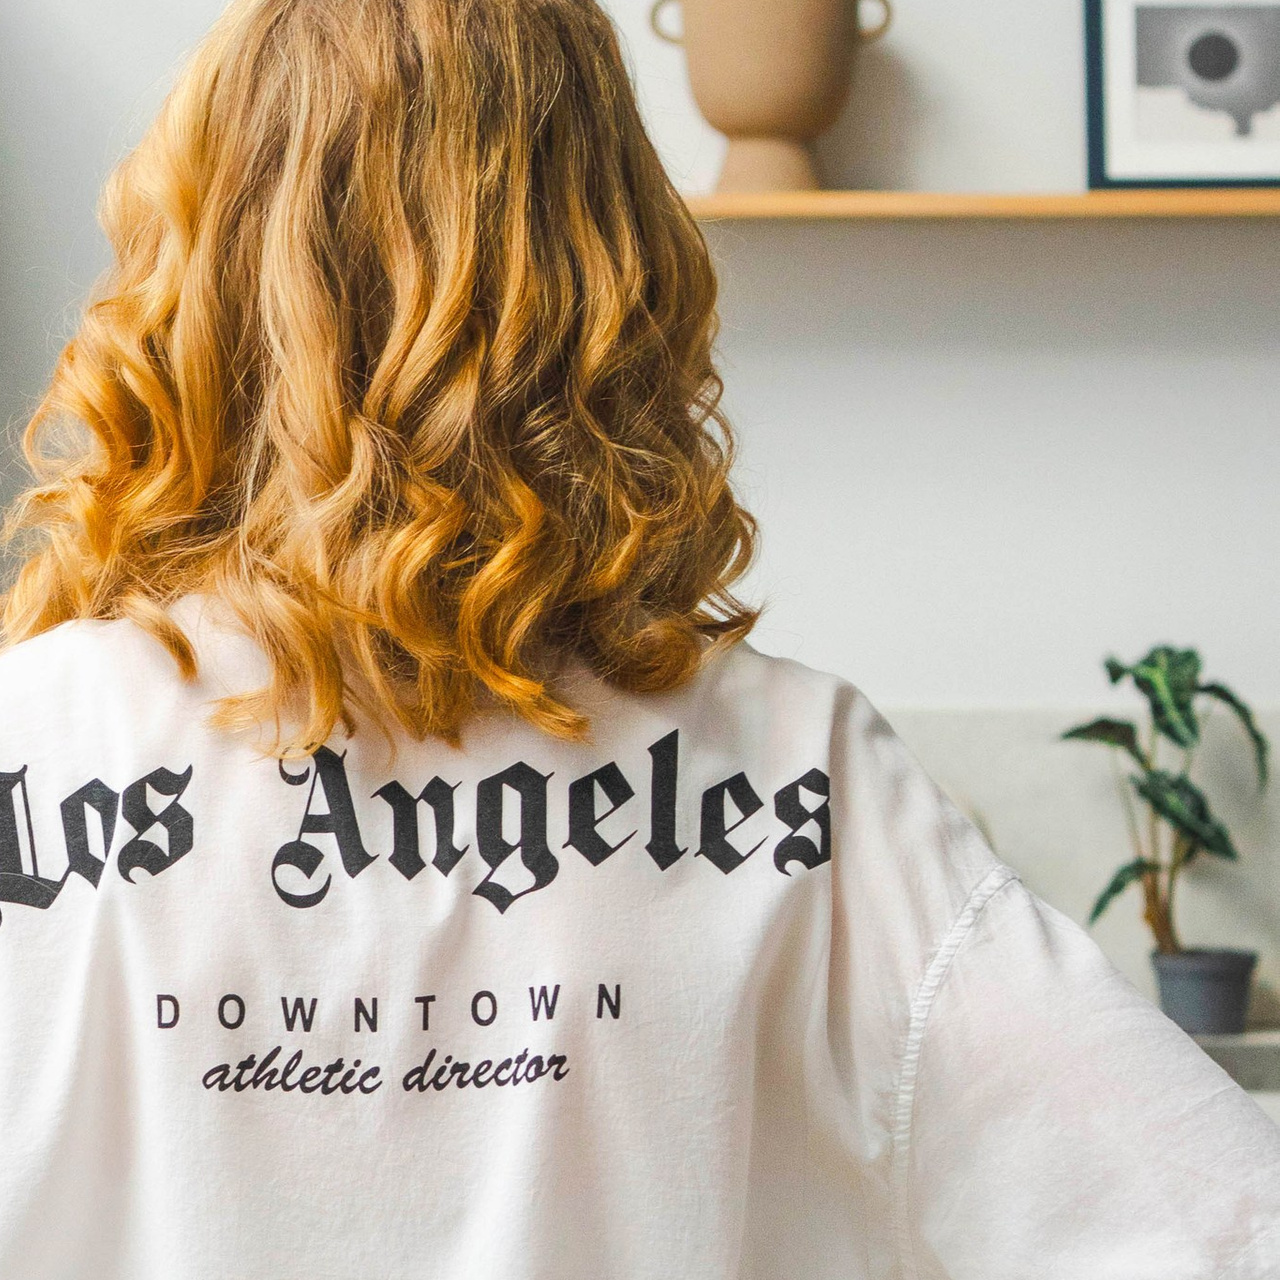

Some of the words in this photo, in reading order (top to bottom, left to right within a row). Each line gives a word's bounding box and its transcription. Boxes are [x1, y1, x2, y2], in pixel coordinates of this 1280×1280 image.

[271, 728, 832, 915] Angeles
[156, 983, 623, 1033] DOWNTOWN
[202, 1045, 384, 1096] athletic
[401, 1048, 571, 1094] director
